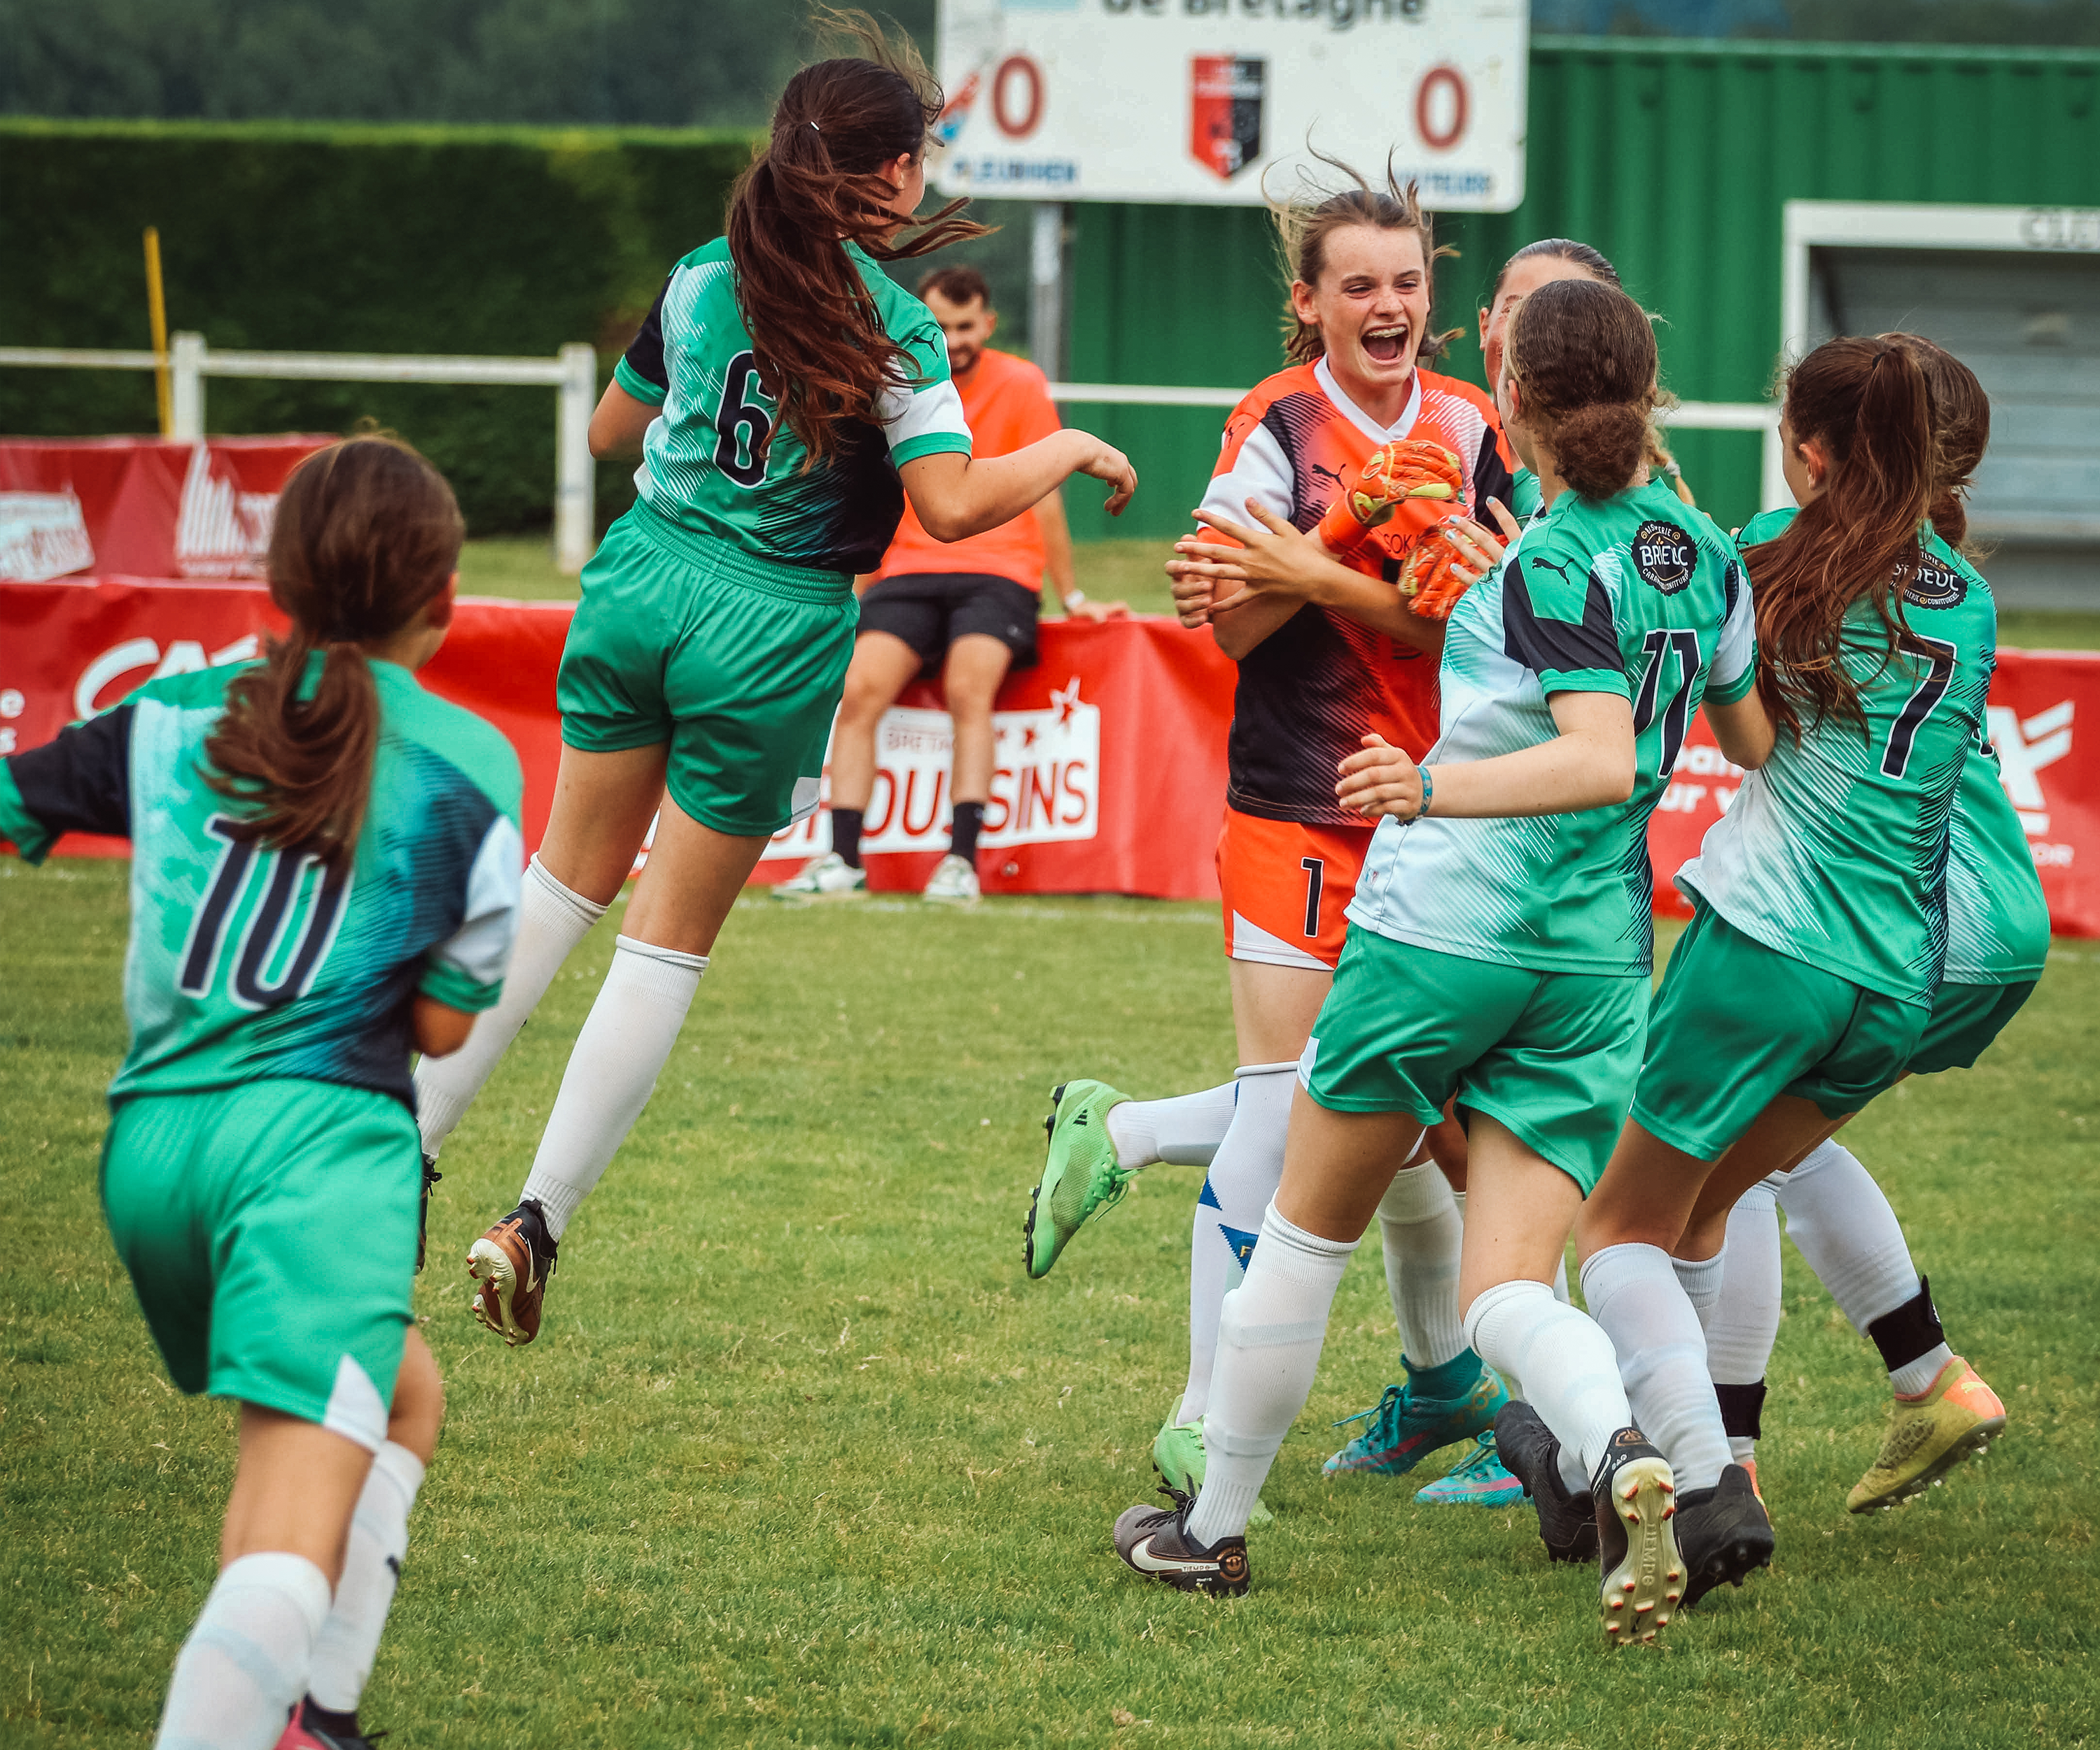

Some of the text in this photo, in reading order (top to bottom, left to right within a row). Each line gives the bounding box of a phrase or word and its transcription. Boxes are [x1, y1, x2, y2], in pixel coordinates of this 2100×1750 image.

[992, 55, 1044, 139] 0
[1416, 64, 1471, 149] 0
[712, 350, 776, 489] 6
[1881, 633, 1958, 780] 7
[172, 812, 355, 1012] 10
[1301, 857, 1324, 938] 1
